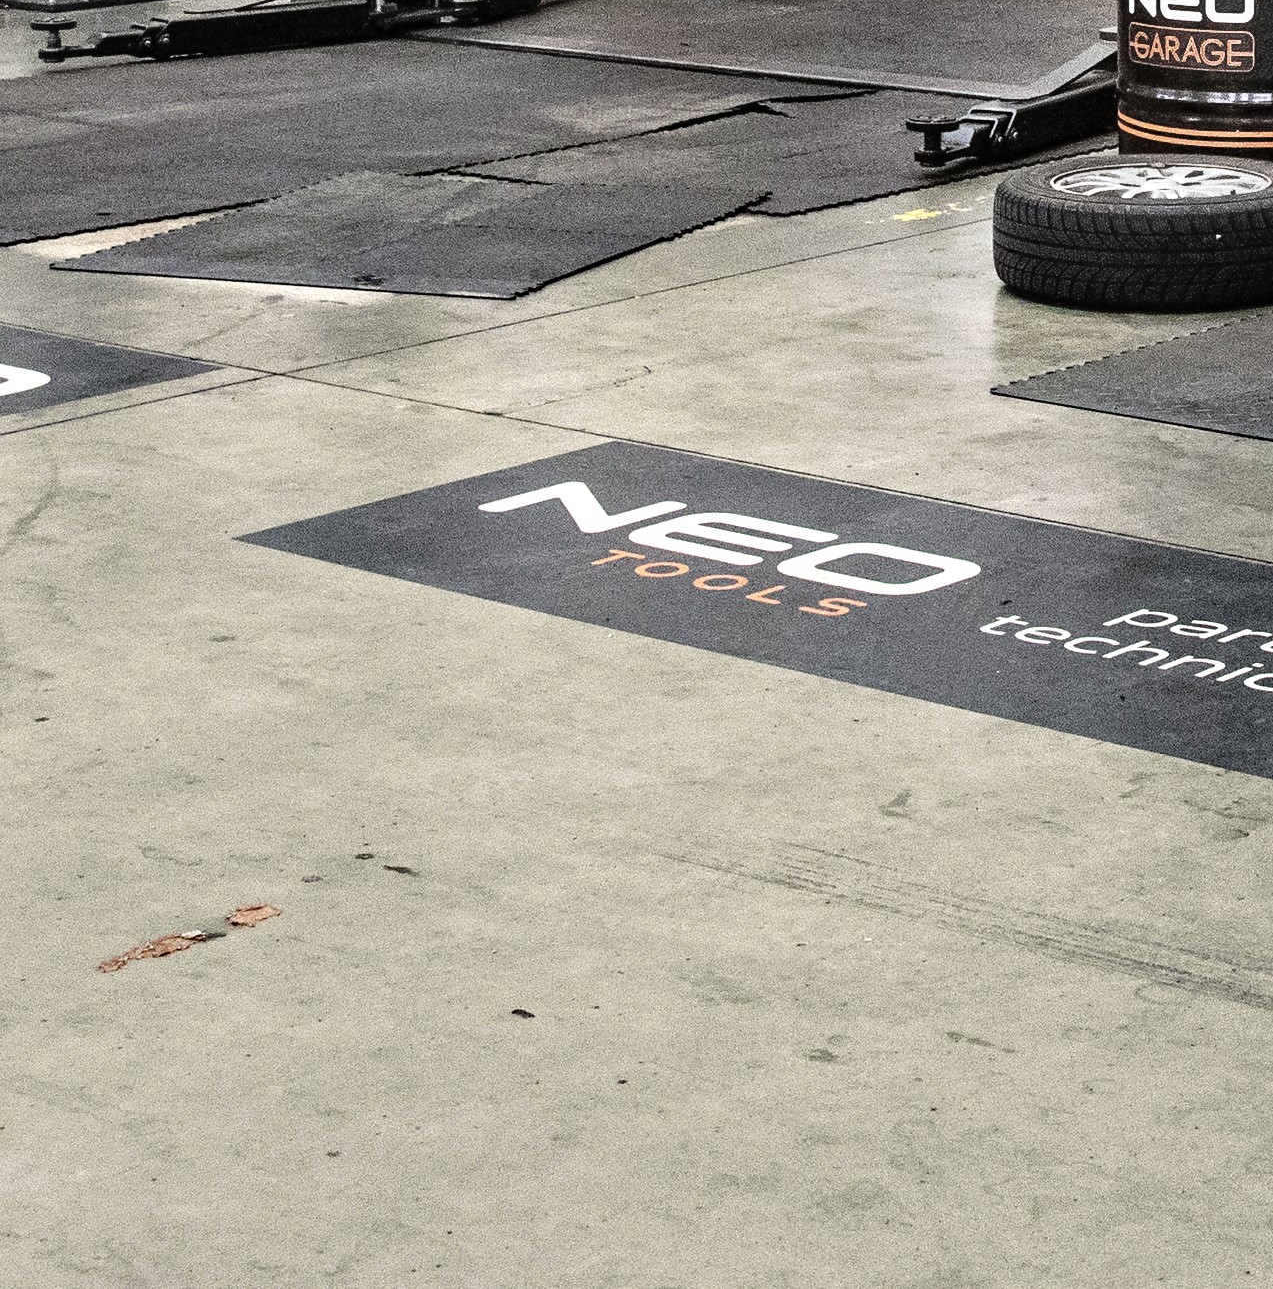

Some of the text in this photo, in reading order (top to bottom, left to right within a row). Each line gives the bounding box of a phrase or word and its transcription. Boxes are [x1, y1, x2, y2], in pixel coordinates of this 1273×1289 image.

[1132, 31, 1250, 67] GARAGE
[478, 480, 981, 597] NEO
[592, 548, 868, 618] TOOLS
